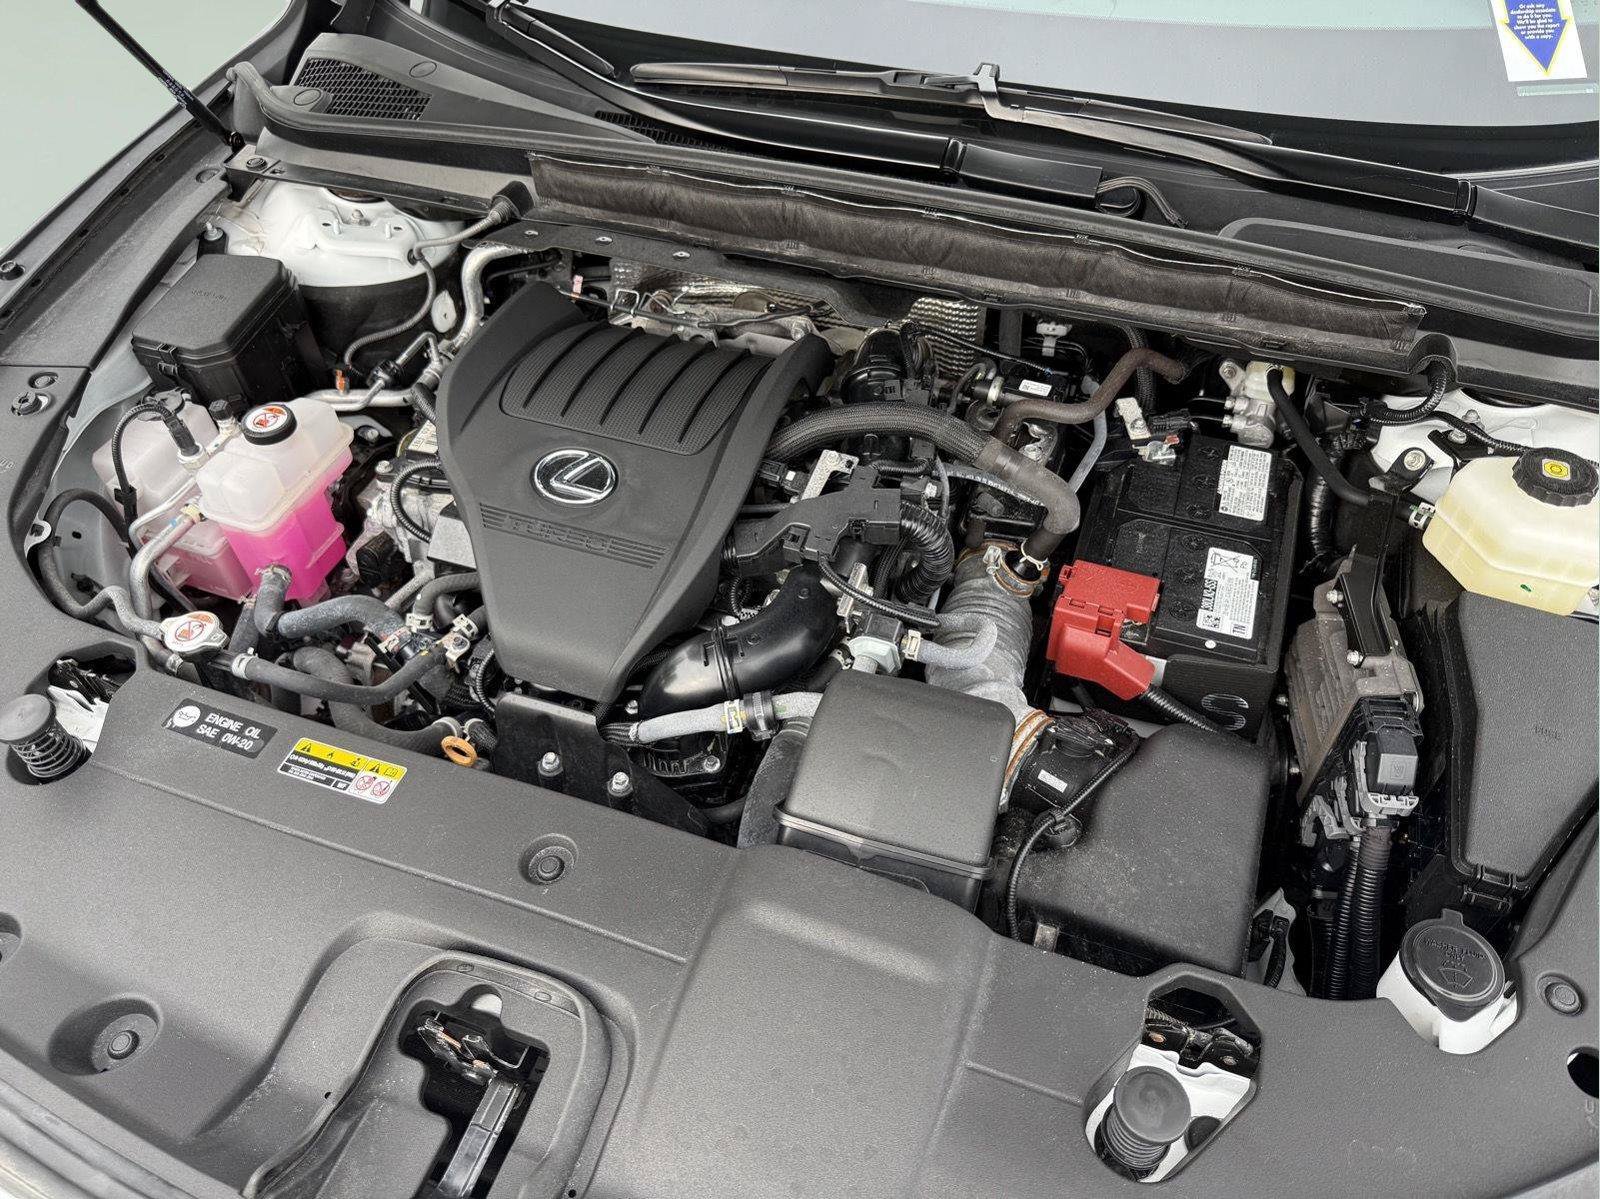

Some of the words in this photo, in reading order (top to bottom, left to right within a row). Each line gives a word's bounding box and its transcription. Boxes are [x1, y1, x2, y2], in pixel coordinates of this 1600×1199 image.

[508, 515, 608, 550] TURBO
[196, 724, 220, 738] SAE
[221, 732, 254, 750] 0W-20
[205, 712, 244, 732] ENGINE
[244, 726, 262, 740] OIL
